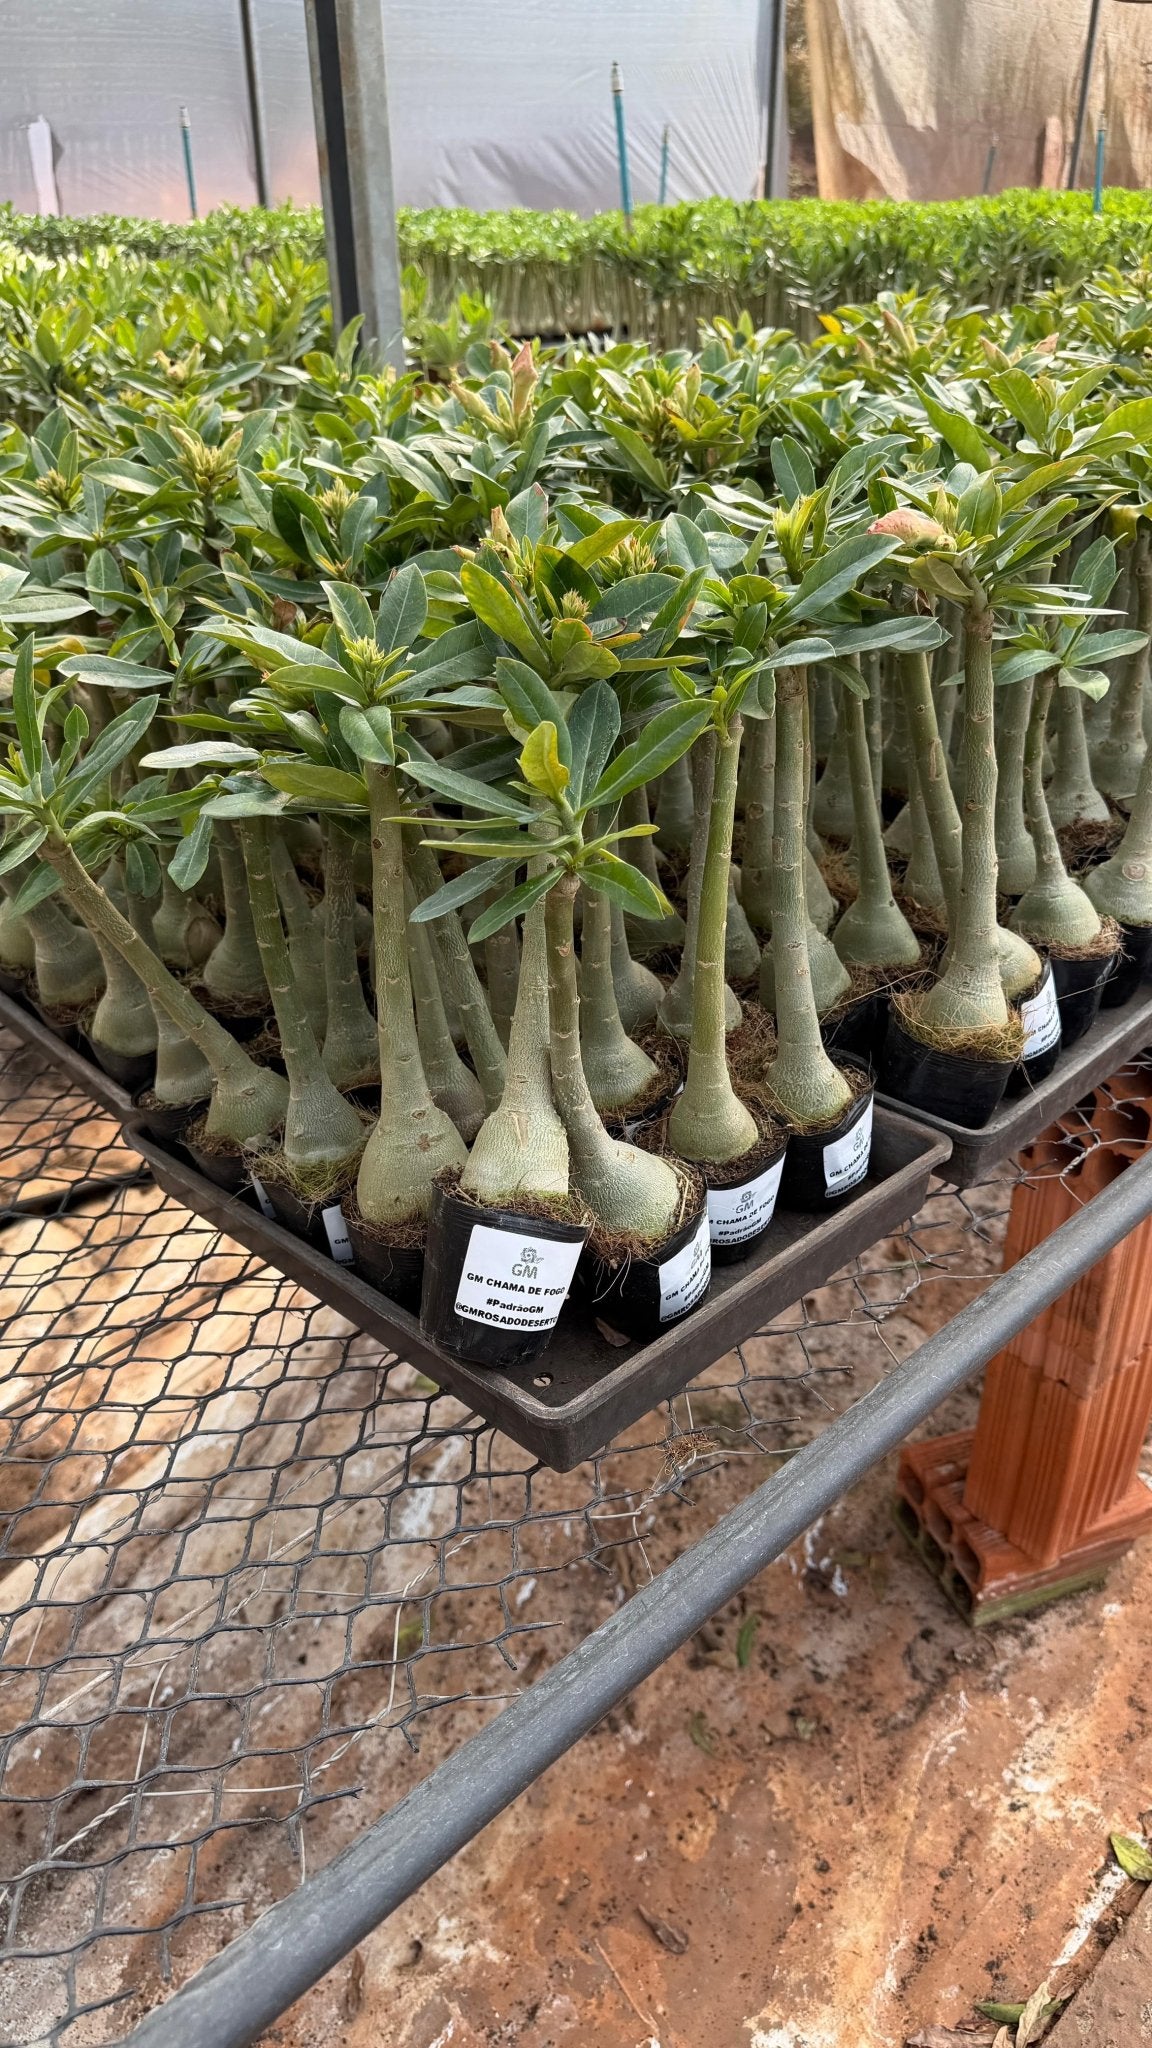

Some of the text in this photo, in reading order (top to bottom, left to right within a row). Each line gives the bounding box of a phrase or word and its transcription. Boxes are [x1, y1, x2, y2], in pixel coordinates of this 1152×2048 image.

[829, 1170, 842, 1178] GM
[735, 1199, 754, 1214] GM
[716, 1215, 748, 1226] CHAMA
[334, 1237, 349, 1245] GM
[511, 1262, 538, 1280] GM
[466, 1272, 566, 1297] GM CHAMA DE FOGO
[665, 1289, 679, 1301] GM
[486, 1297, 545, 1315] #PadrãoGM
